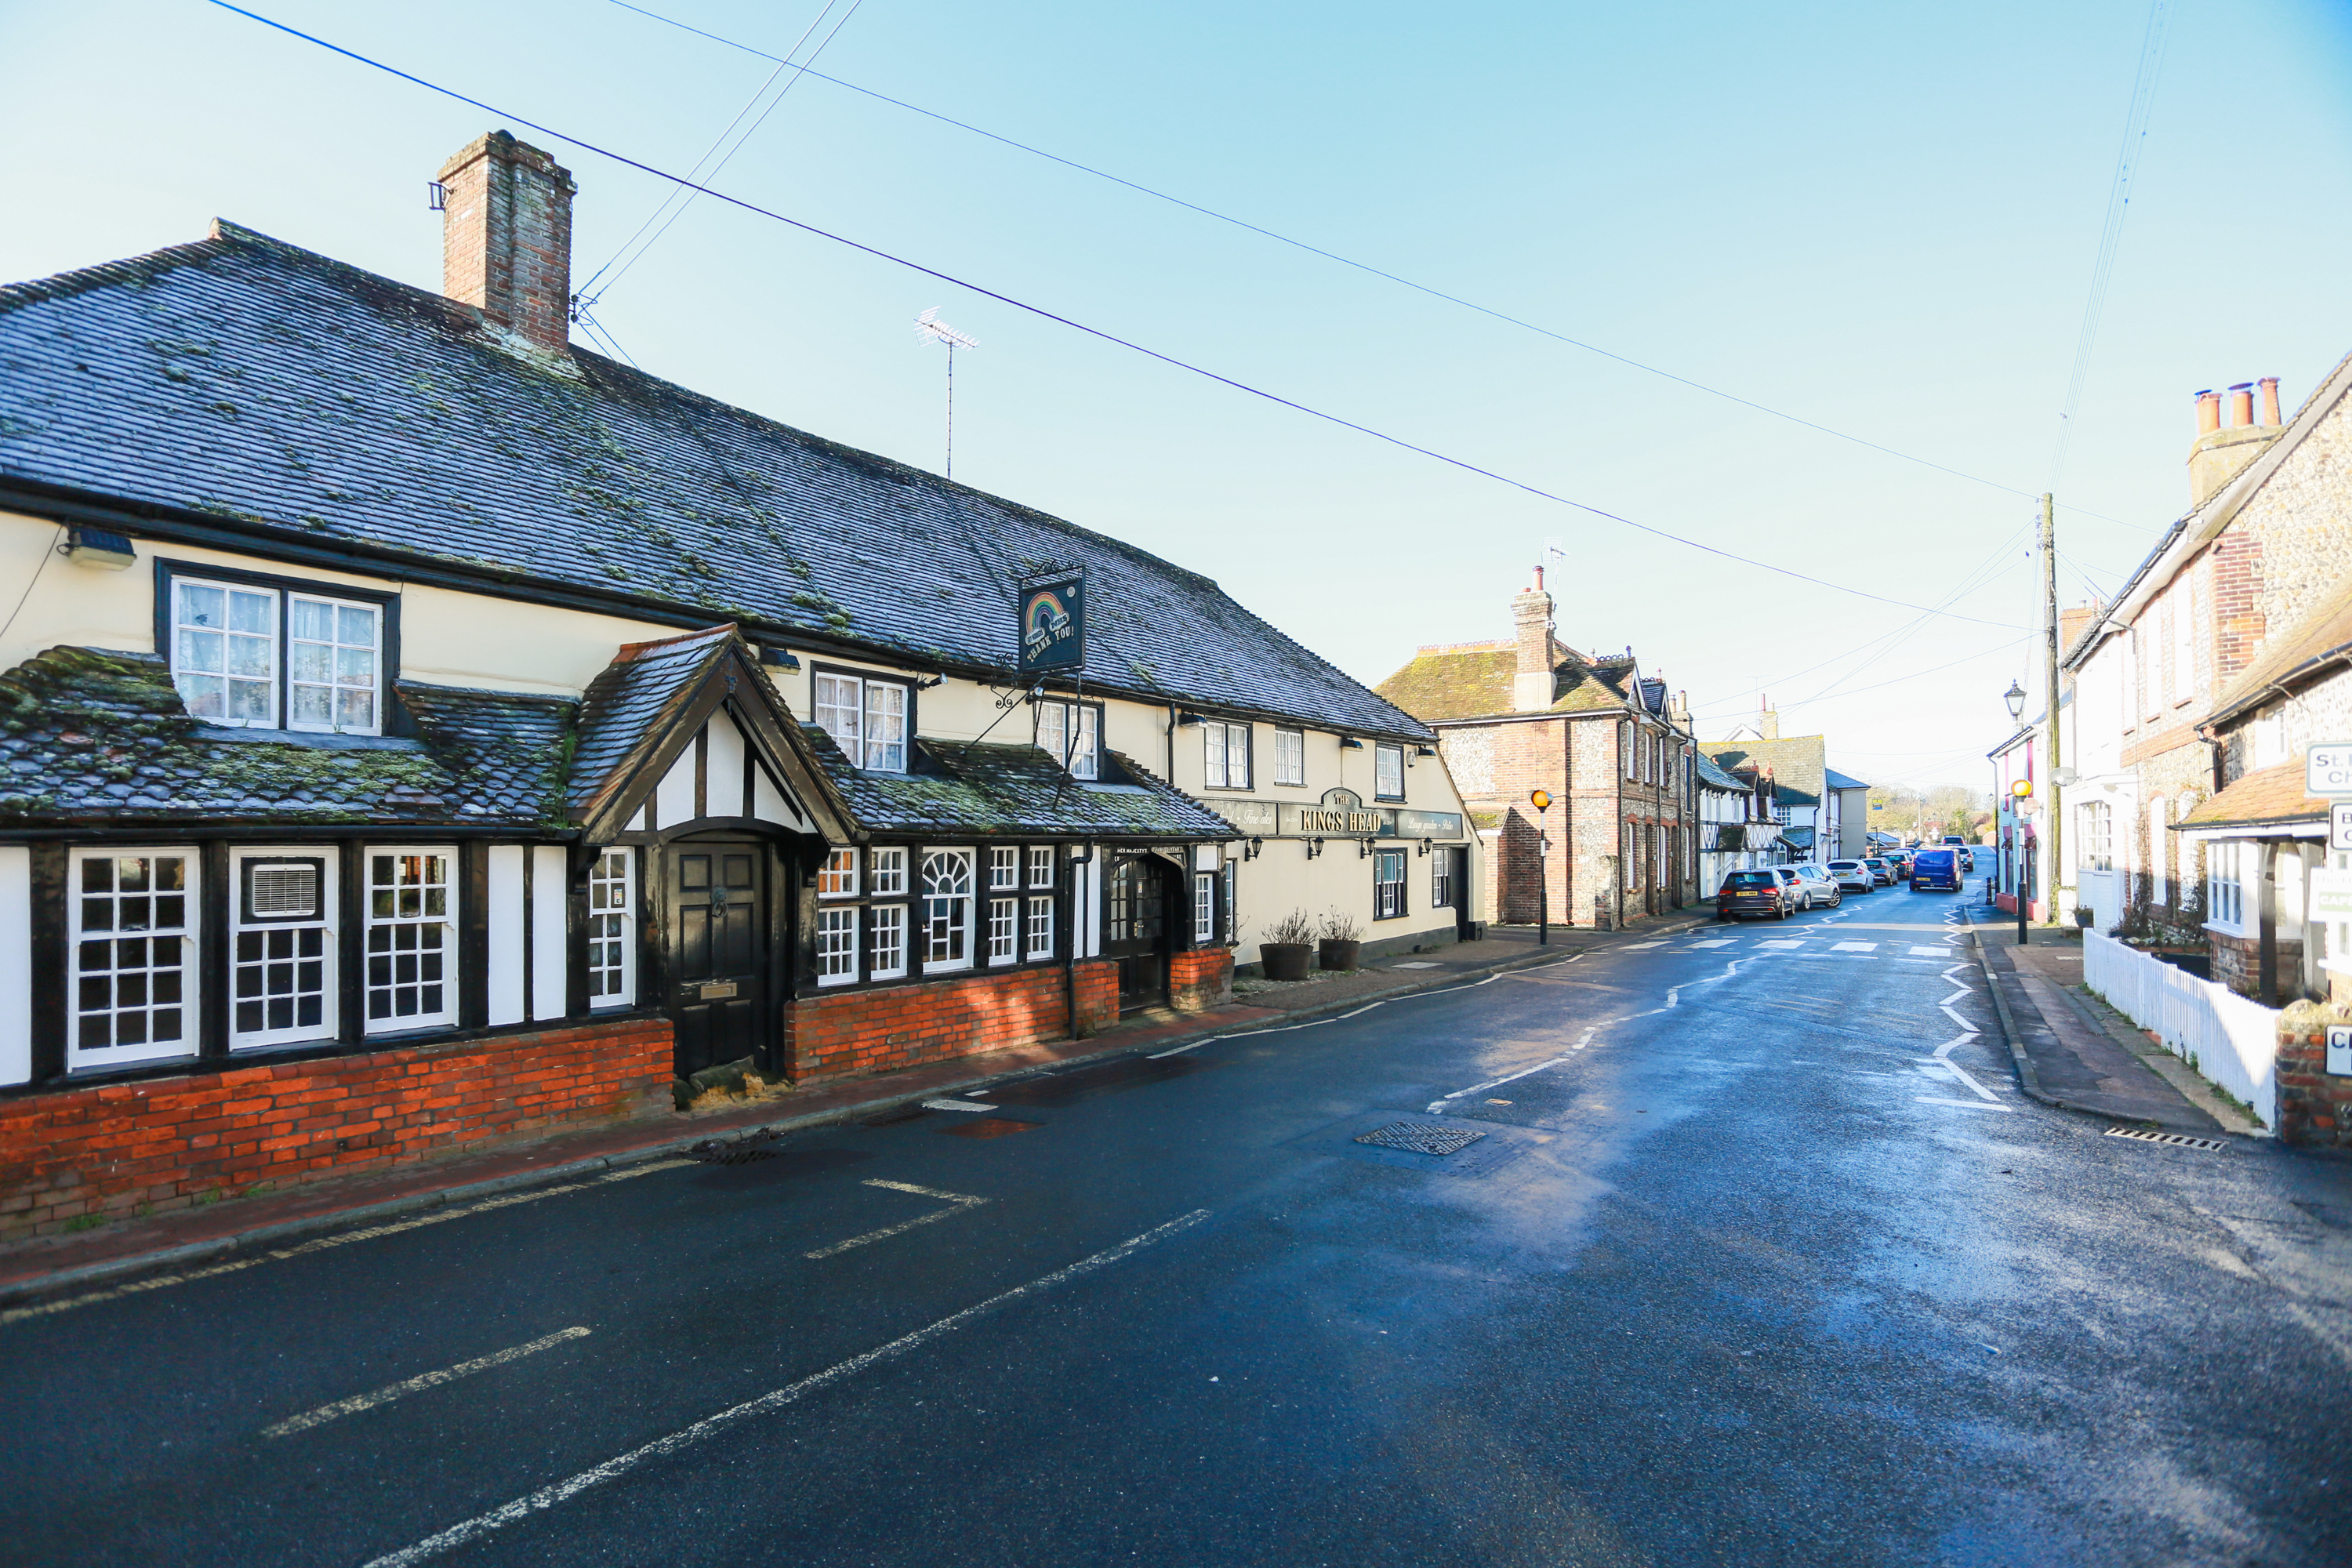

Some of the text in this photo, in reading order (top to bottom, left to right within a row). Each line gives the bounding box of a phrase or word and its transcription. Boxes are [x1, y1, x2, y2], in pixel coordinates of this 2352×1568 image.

[1051, 615, 1067, 628] NHS
[1027, 626, 1074, 662] THANK YOU!
[2315, 753, 2344, 767] St.
[1334, 794, 1349, 804] THE
[1243, 809, 1259, 825] Fine
[1260, 811, 1272, 825] ales
[1301, 810, 1381, 832] KINGS HEAD
[1408, 817, 1454, 832] Large garden Patio
